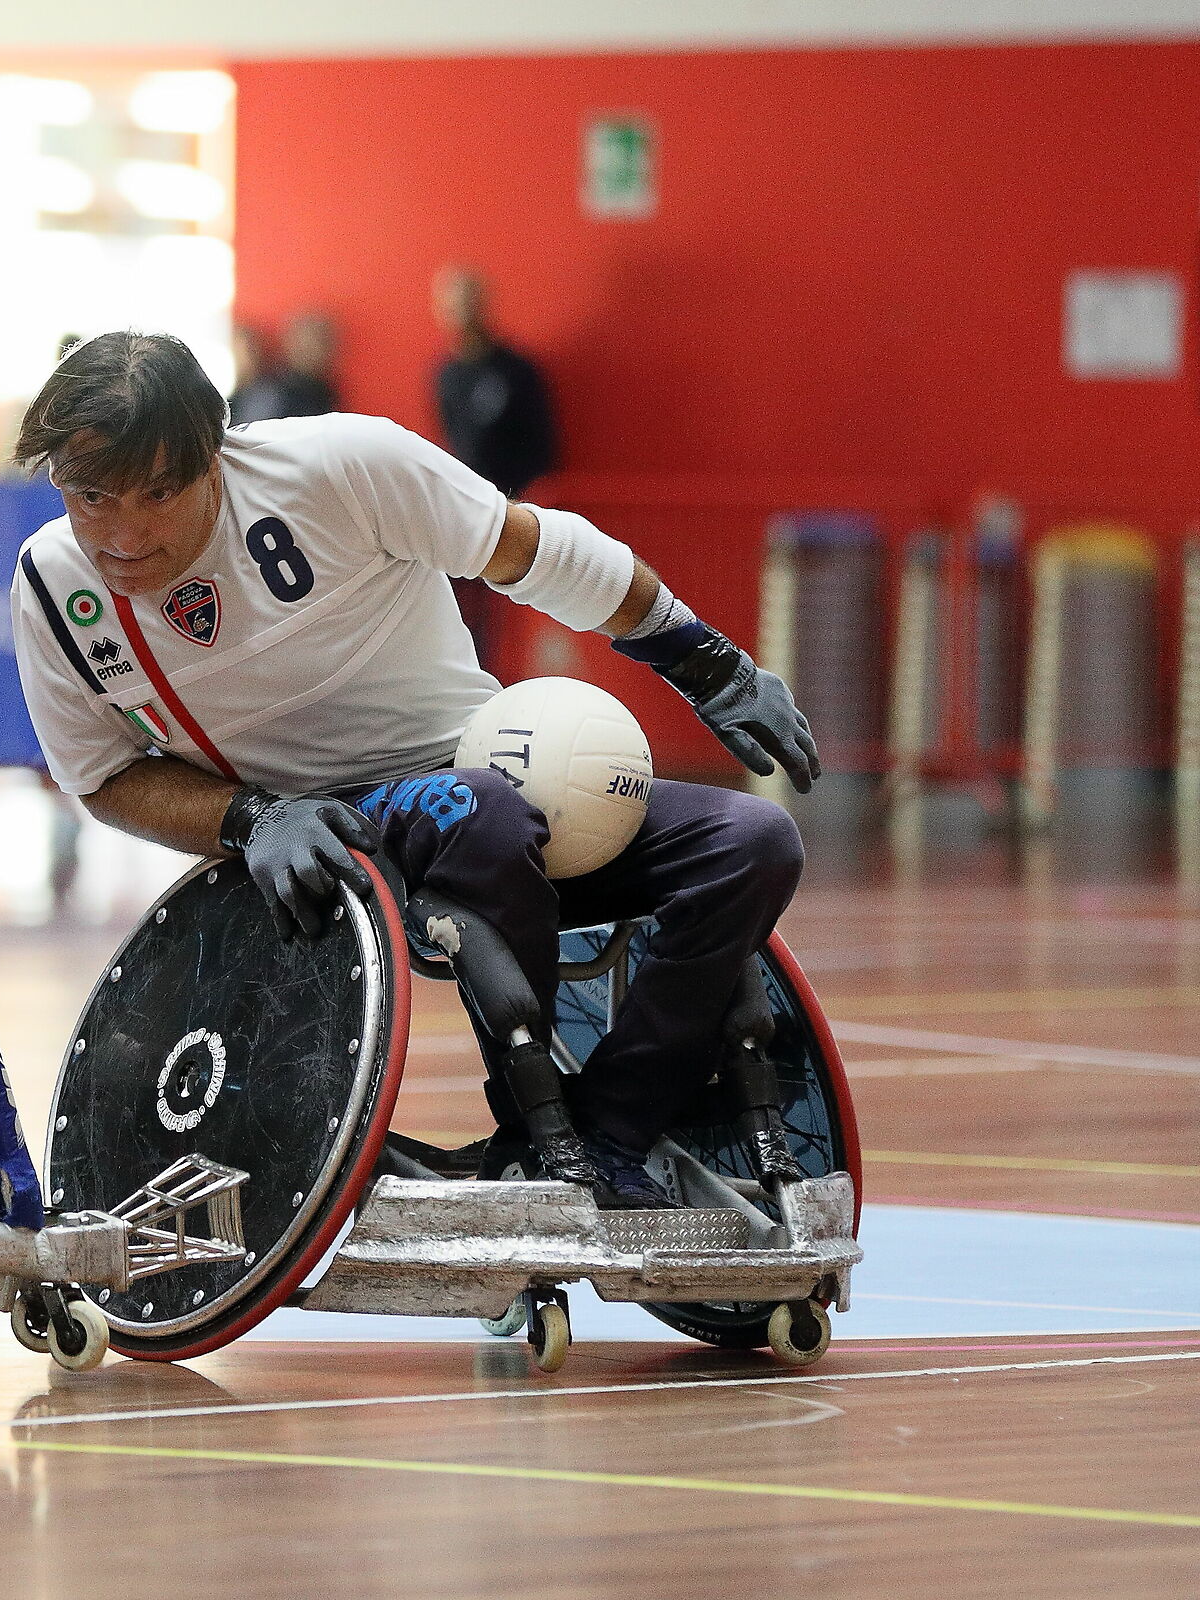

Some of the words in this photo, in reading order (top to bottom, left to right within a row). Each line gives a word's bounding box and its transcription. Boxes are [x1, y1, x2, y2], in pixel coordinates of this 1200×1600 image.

[246, 517, 314, 602] 8
[97, 660, 134, 680] errea
[606, 775, 649, 801] IWRF
